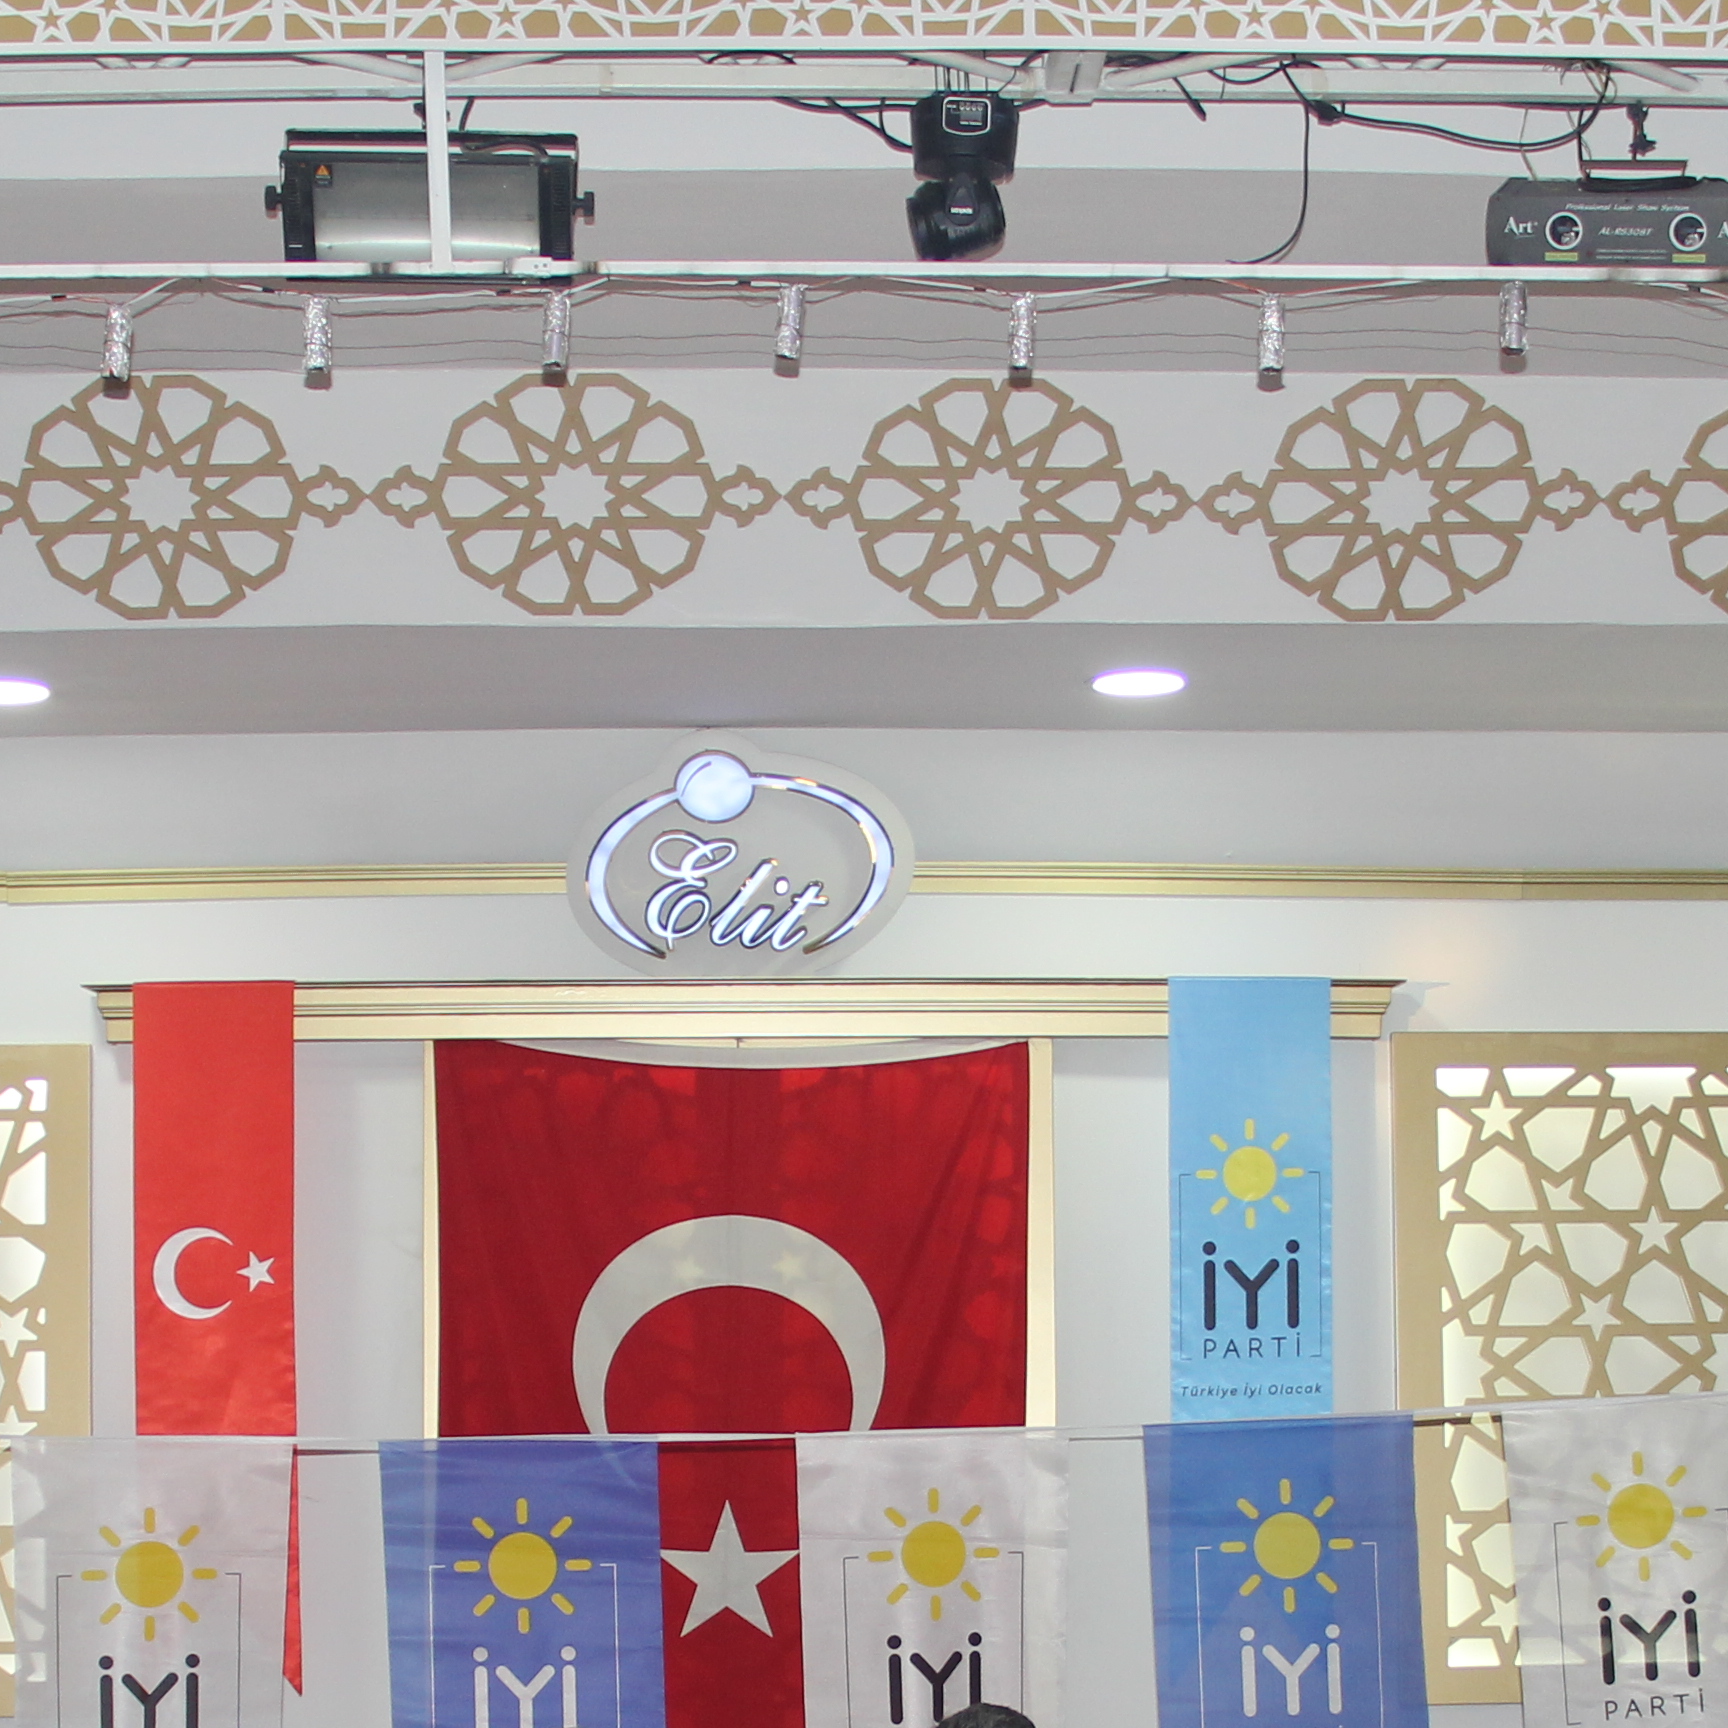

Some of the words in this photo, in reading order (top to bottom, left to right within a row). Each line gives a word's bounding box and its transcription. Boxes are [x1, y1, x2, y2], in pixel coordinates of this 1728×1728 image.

[1504, 216, 1533, 235] Art
[645, 829, 829, 952] Elit
[1203, 1332, 1301, 1359] PARTİ
[1181, 1386, 1238, 1399] Türkiye
[1243, 1382, 1262, 1398] İyi
[1268, 1382, 1322, 1396] Olacak
[1604, 1687, 1705, 1720] PARTİ
